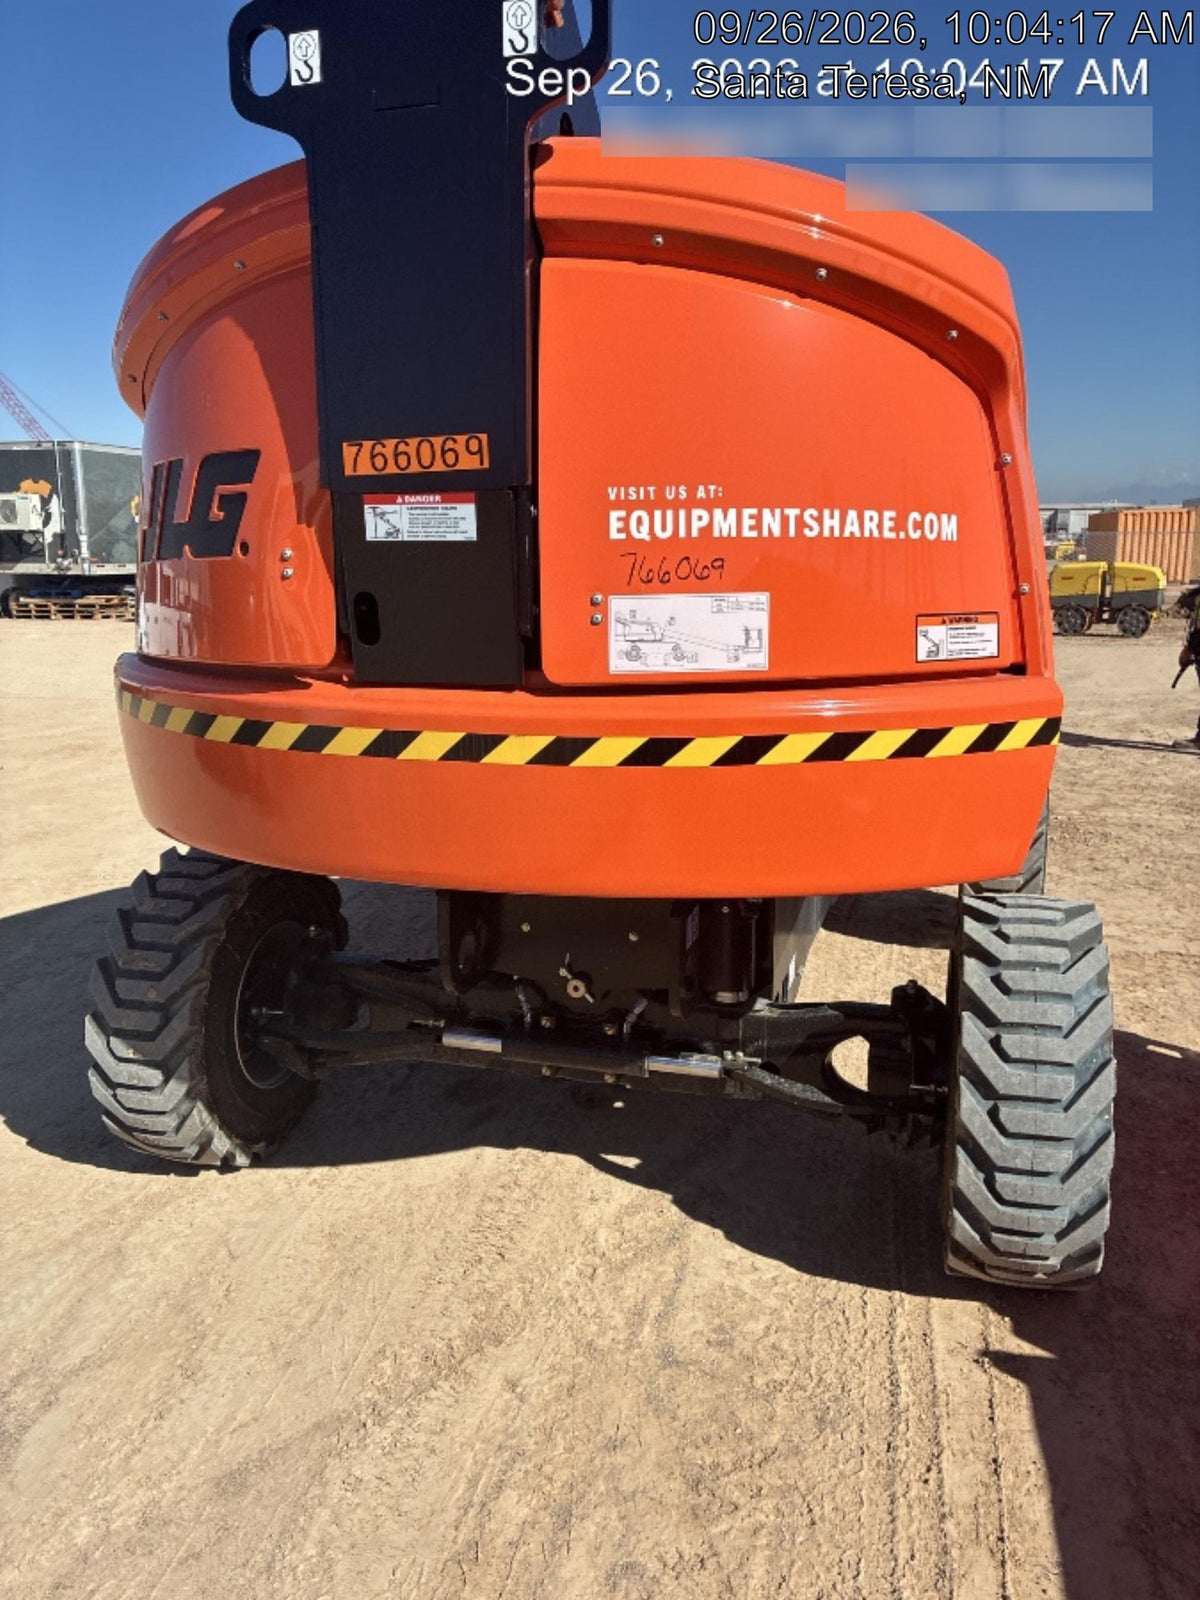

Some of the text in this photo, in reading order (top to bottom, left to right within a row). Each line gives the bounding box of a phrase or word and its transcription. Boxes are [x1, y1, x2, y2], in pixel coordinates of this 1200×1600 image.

[346, 435, 484, 473] 766069
[608, 485, 723, 500] VISIT US AT:
[609, 508, 958, 541] EQUIPMENTSHARE.COM
[620, 552, 726, 587] 766069
